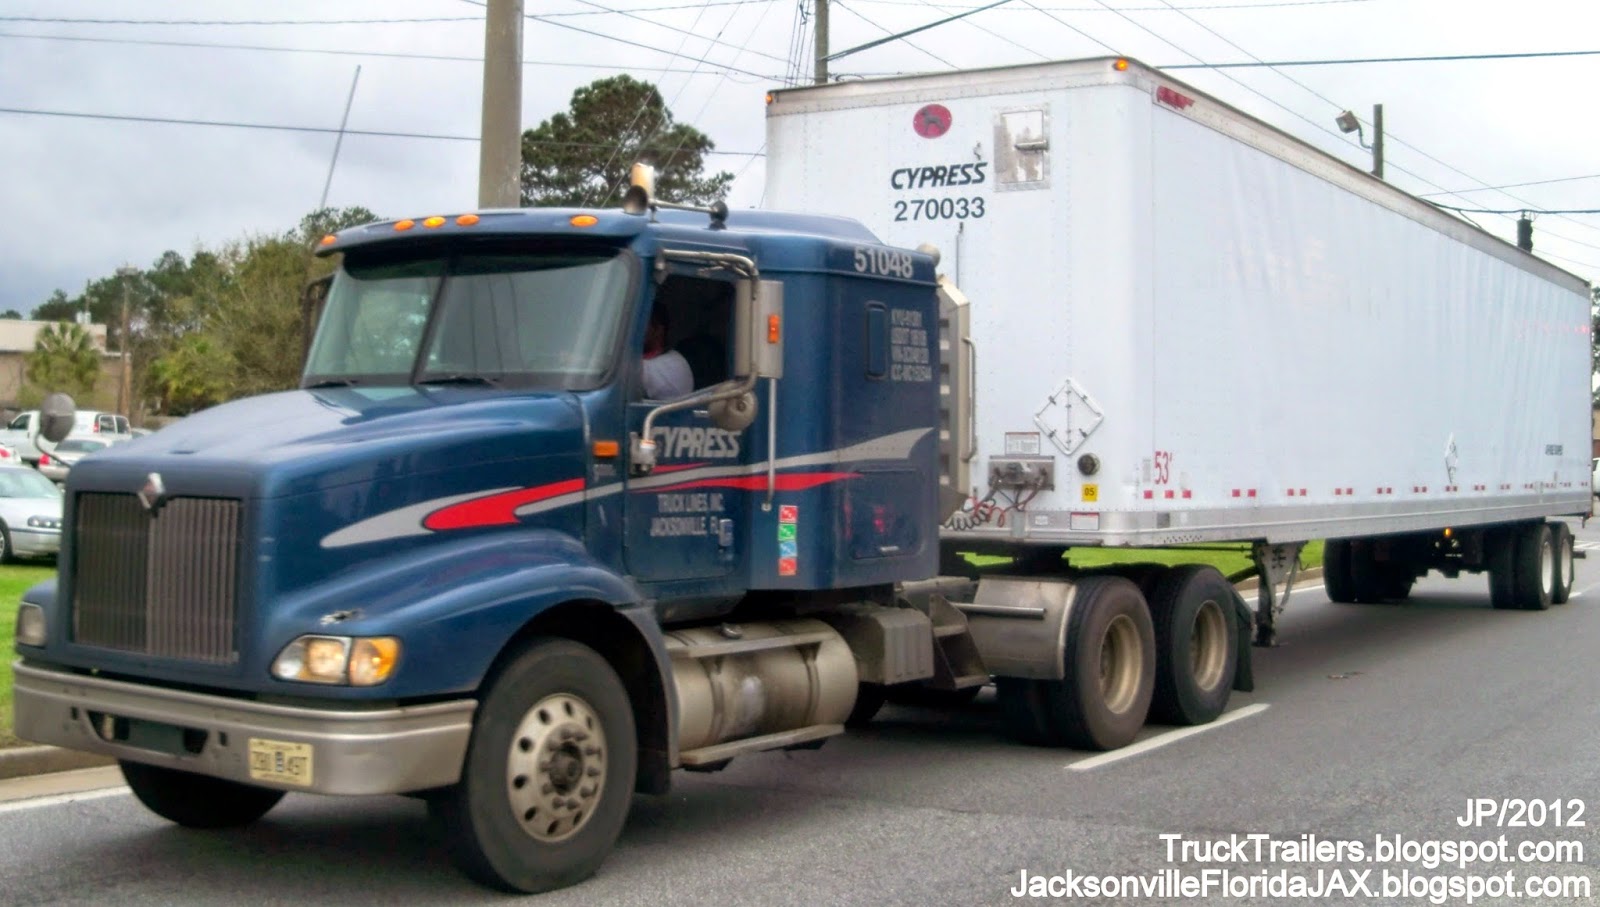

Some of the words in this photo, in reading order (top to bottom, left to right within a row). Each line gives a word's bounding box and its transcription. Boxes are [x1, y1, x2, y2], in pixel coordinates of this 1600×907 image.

[891, 162, 988, 190] CYPRESS
[894, 197, 985, 222] 270033
[854, 247, 914, 278] 51048
[657, 493, 684, 513] TRUCK
[685, 493, 708, 512] LINES
[1084, 487, 1095, 496] 05
[650, 516, 707, 537] JACKSONVILLE
